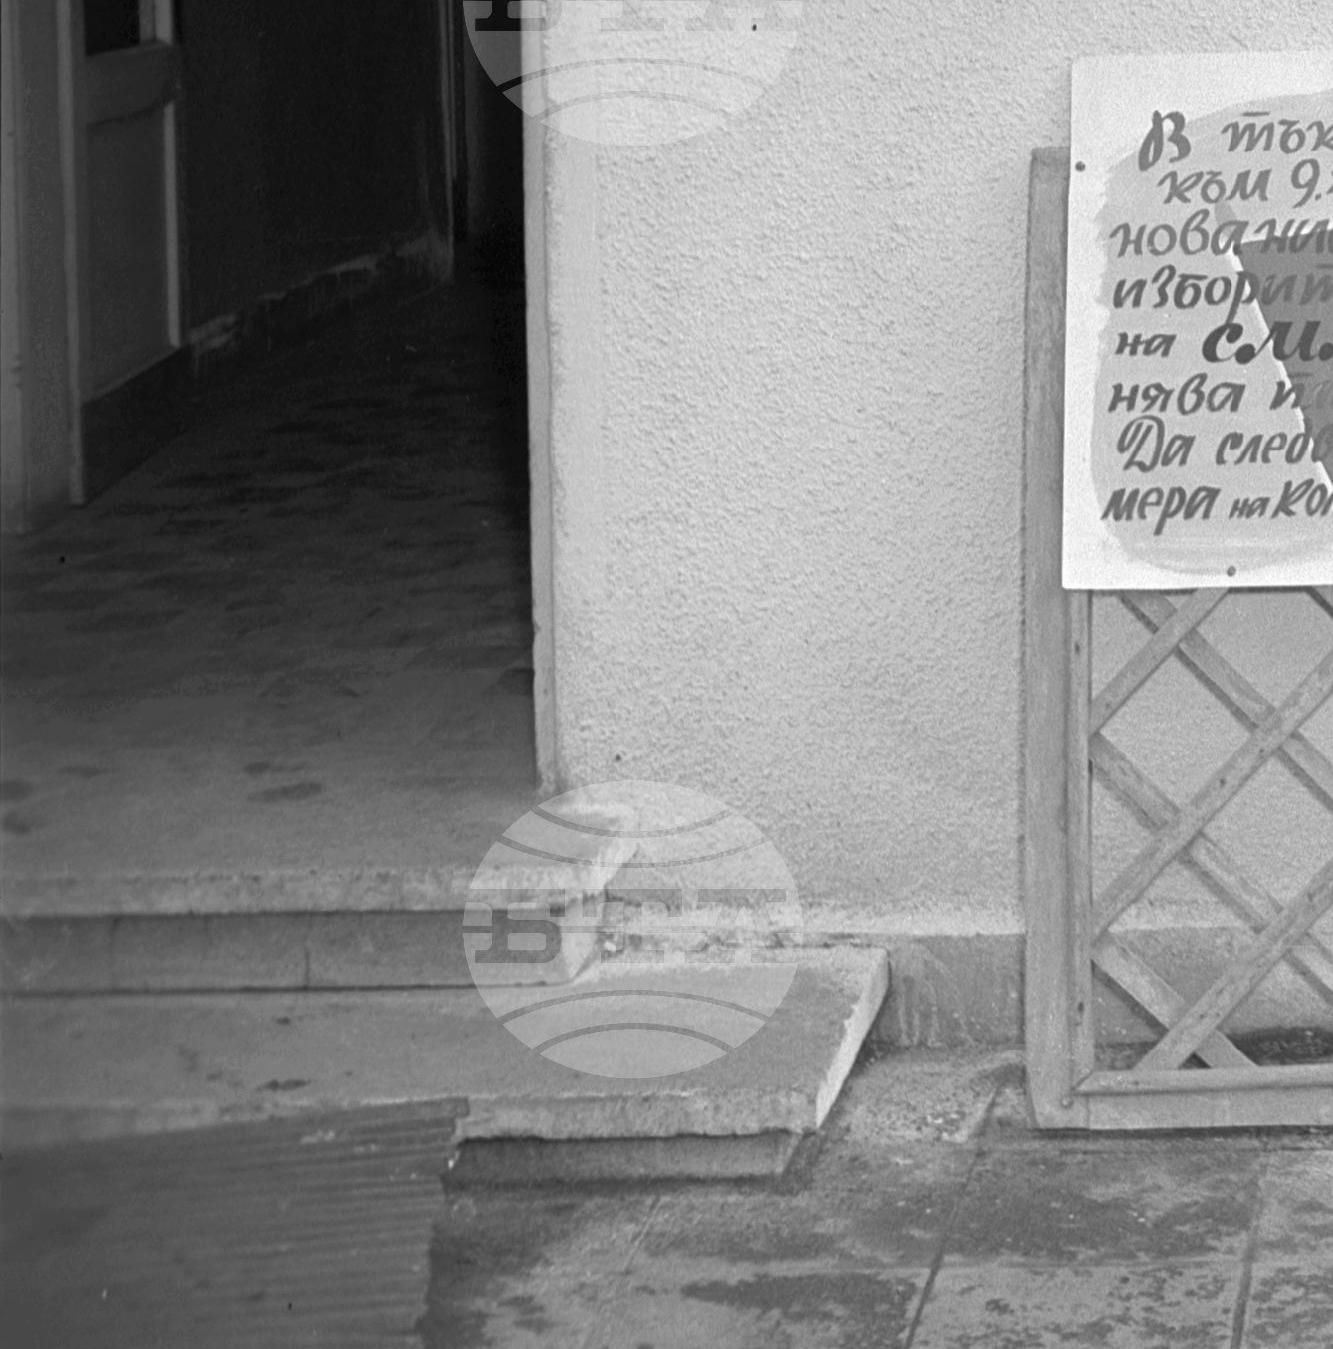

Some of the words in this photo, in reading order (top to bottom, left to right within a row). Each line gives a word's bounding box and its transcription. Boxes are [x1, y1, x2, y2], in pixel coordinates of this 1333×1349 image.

[1139, 110, 1191, 171] В
[1157, 168, 1272, 204] към
[1115, 332, 1177, 358] на
[1108, 373, 1246, 416] нява
[1117, 415, 1196, 473] Да
[1101, 485, 1222, 536] мера
[1229, 496, 1271, 520] на
